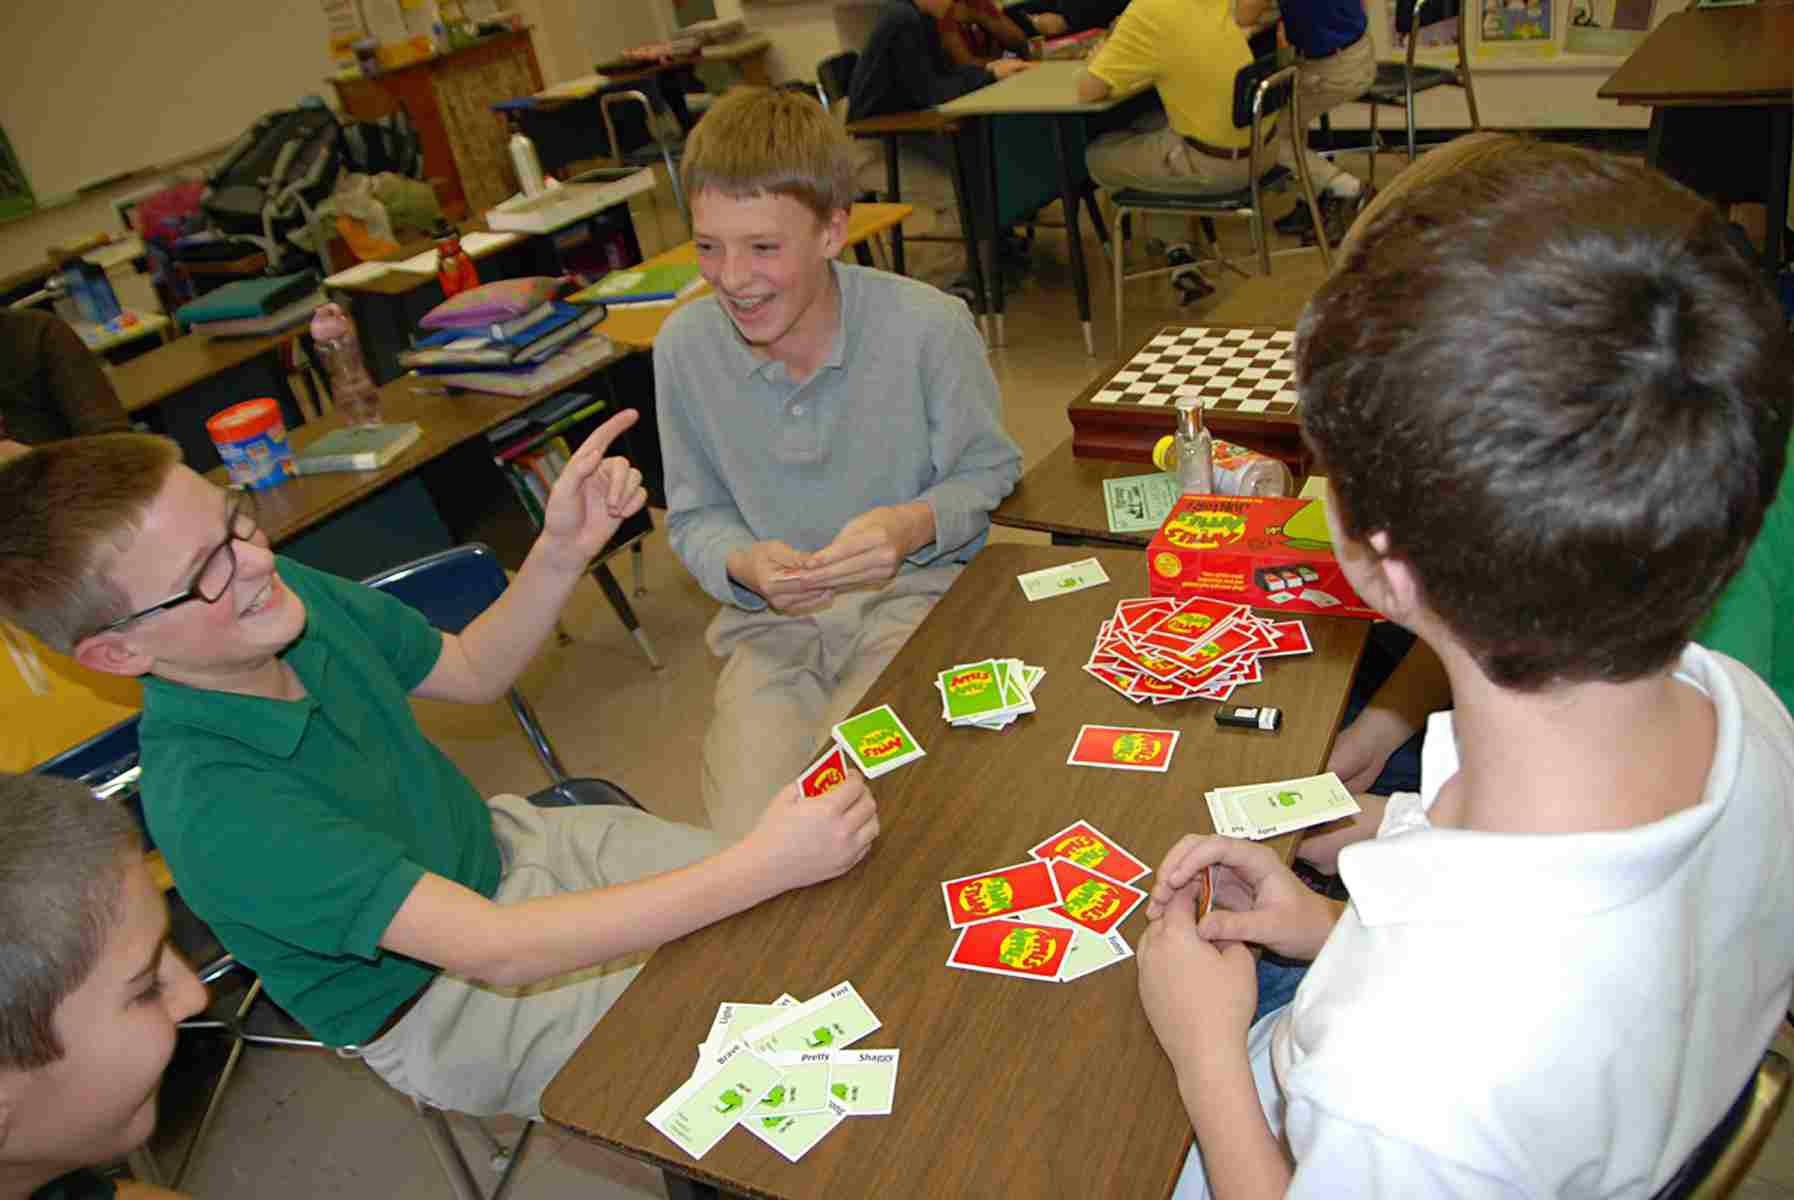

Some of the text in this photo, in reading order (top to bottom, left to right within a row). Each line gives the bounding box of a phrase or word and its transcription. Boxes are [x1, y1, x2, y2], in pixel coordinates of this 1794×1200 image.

[830, 985, 850, 999] Fast
[715, 1043, 741, 1065] Brave
[801, 1053, 830, 1064] Pretty
[858, 1053, 894, 1064] Shaggy
